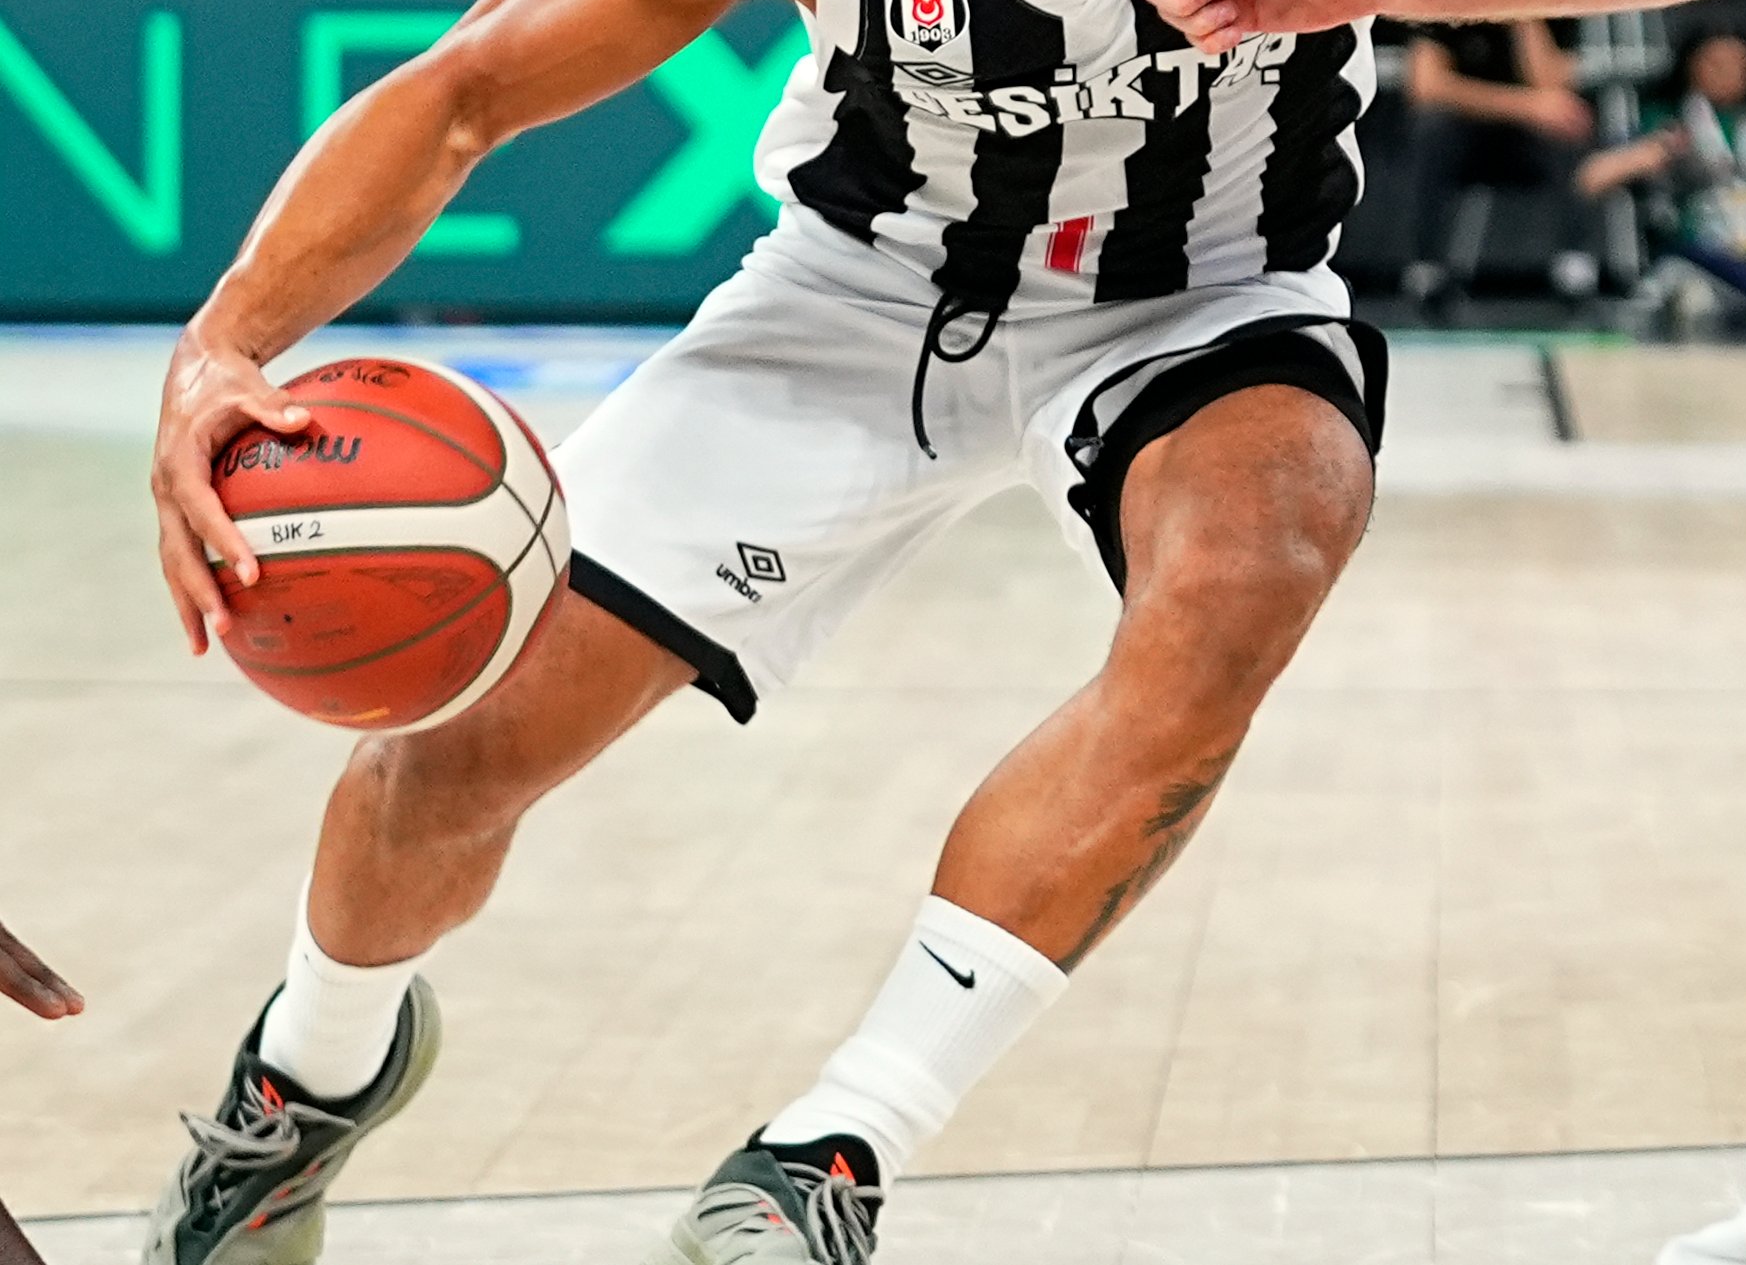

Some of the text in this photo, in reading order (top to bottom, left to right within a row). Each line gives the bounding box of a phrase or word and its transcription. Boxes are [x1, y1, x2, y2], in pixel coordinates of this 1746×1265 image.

[911, 27, 952, 43] 1903
[222, 435, 362, 478] molten
[307, 519, 325, 540] 2
